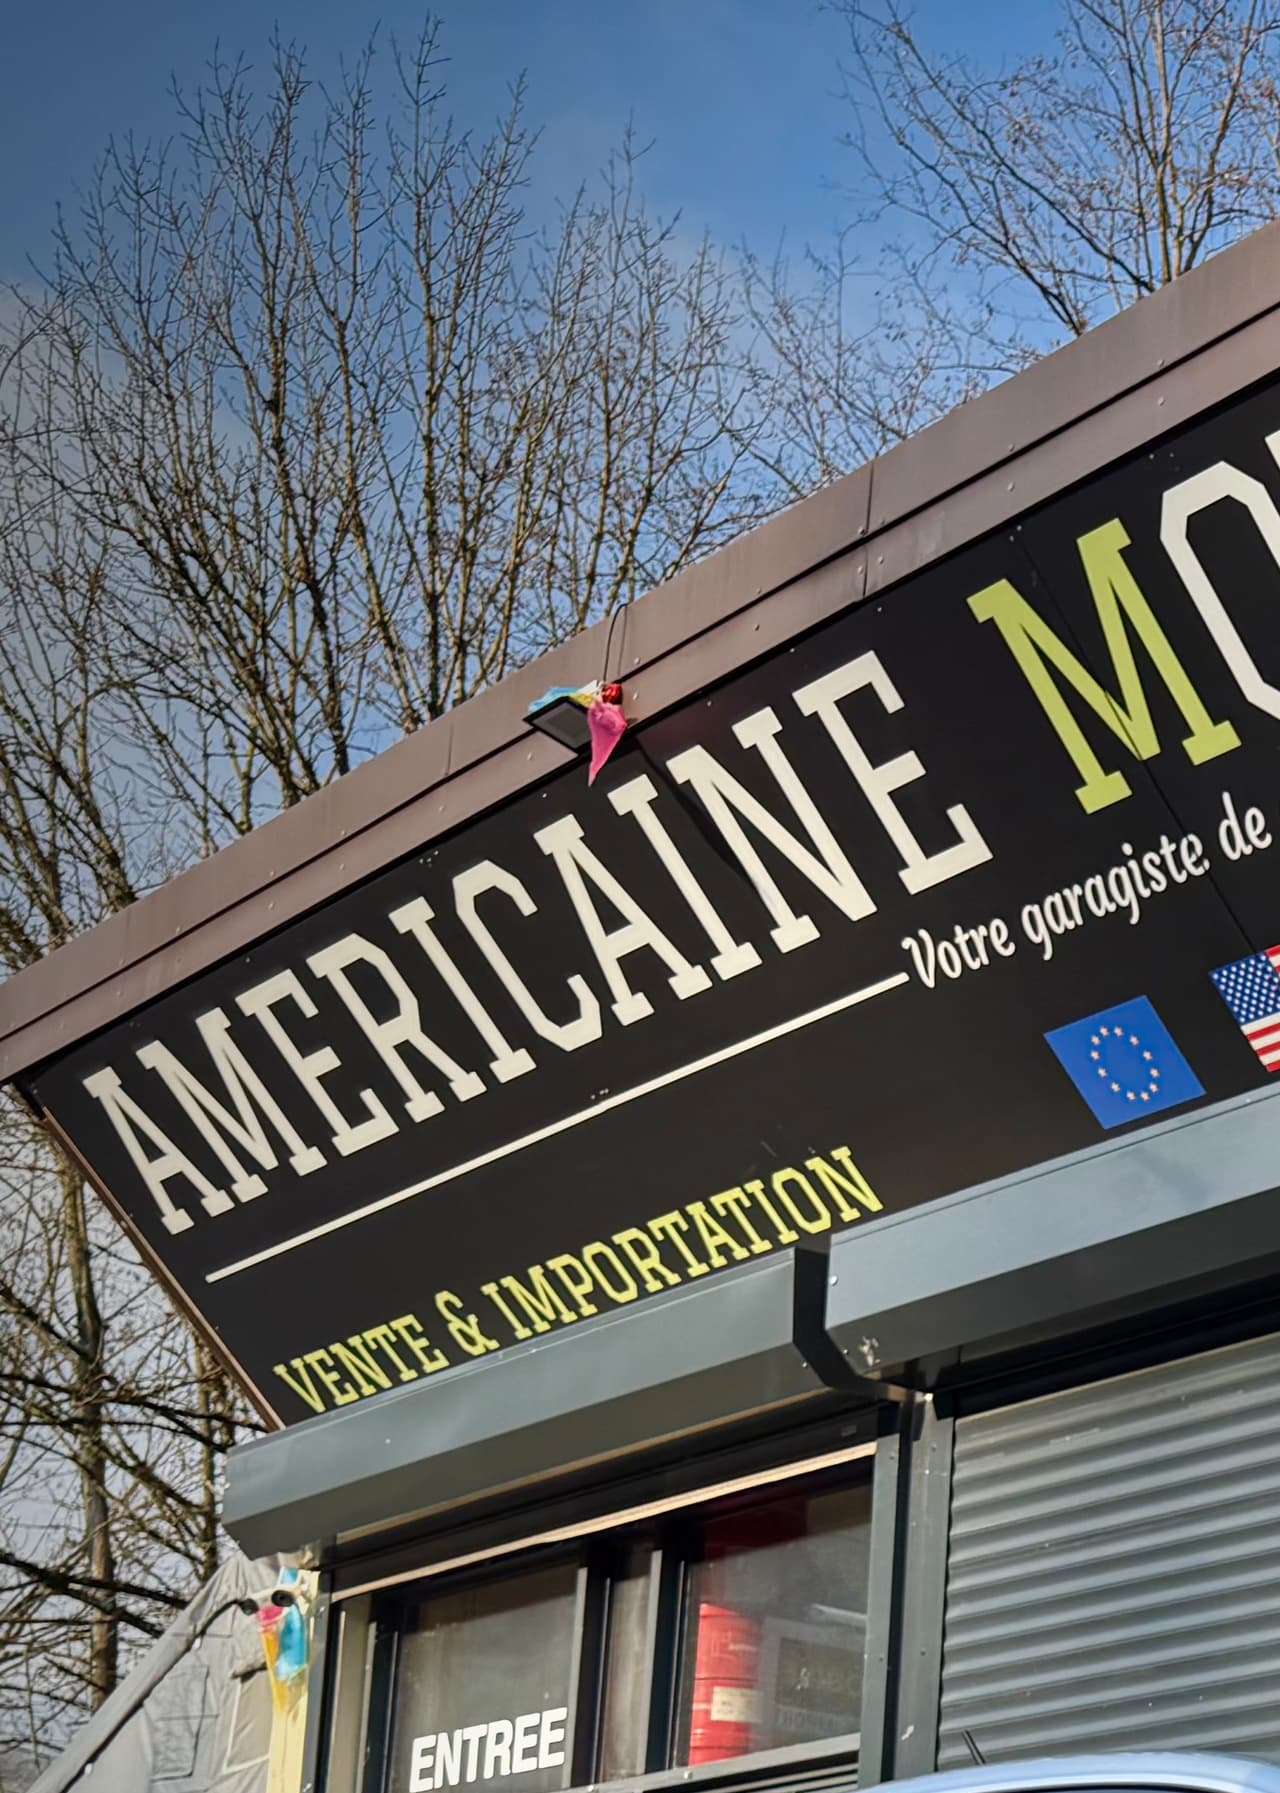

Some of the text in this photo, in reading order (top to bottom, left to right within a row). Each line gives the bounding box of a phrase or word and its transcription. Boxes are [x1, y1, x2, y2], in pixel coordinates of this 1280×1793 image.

[82, 650, 994, 1235] AMERICAINE
[901, 919, 1016, 990] Votre
[1020, 831, 1210, 960] garagiste
[1218, 794, 1272, 863] de
[273, 1146, 883, 1414] VENTE & IMPORTATION
